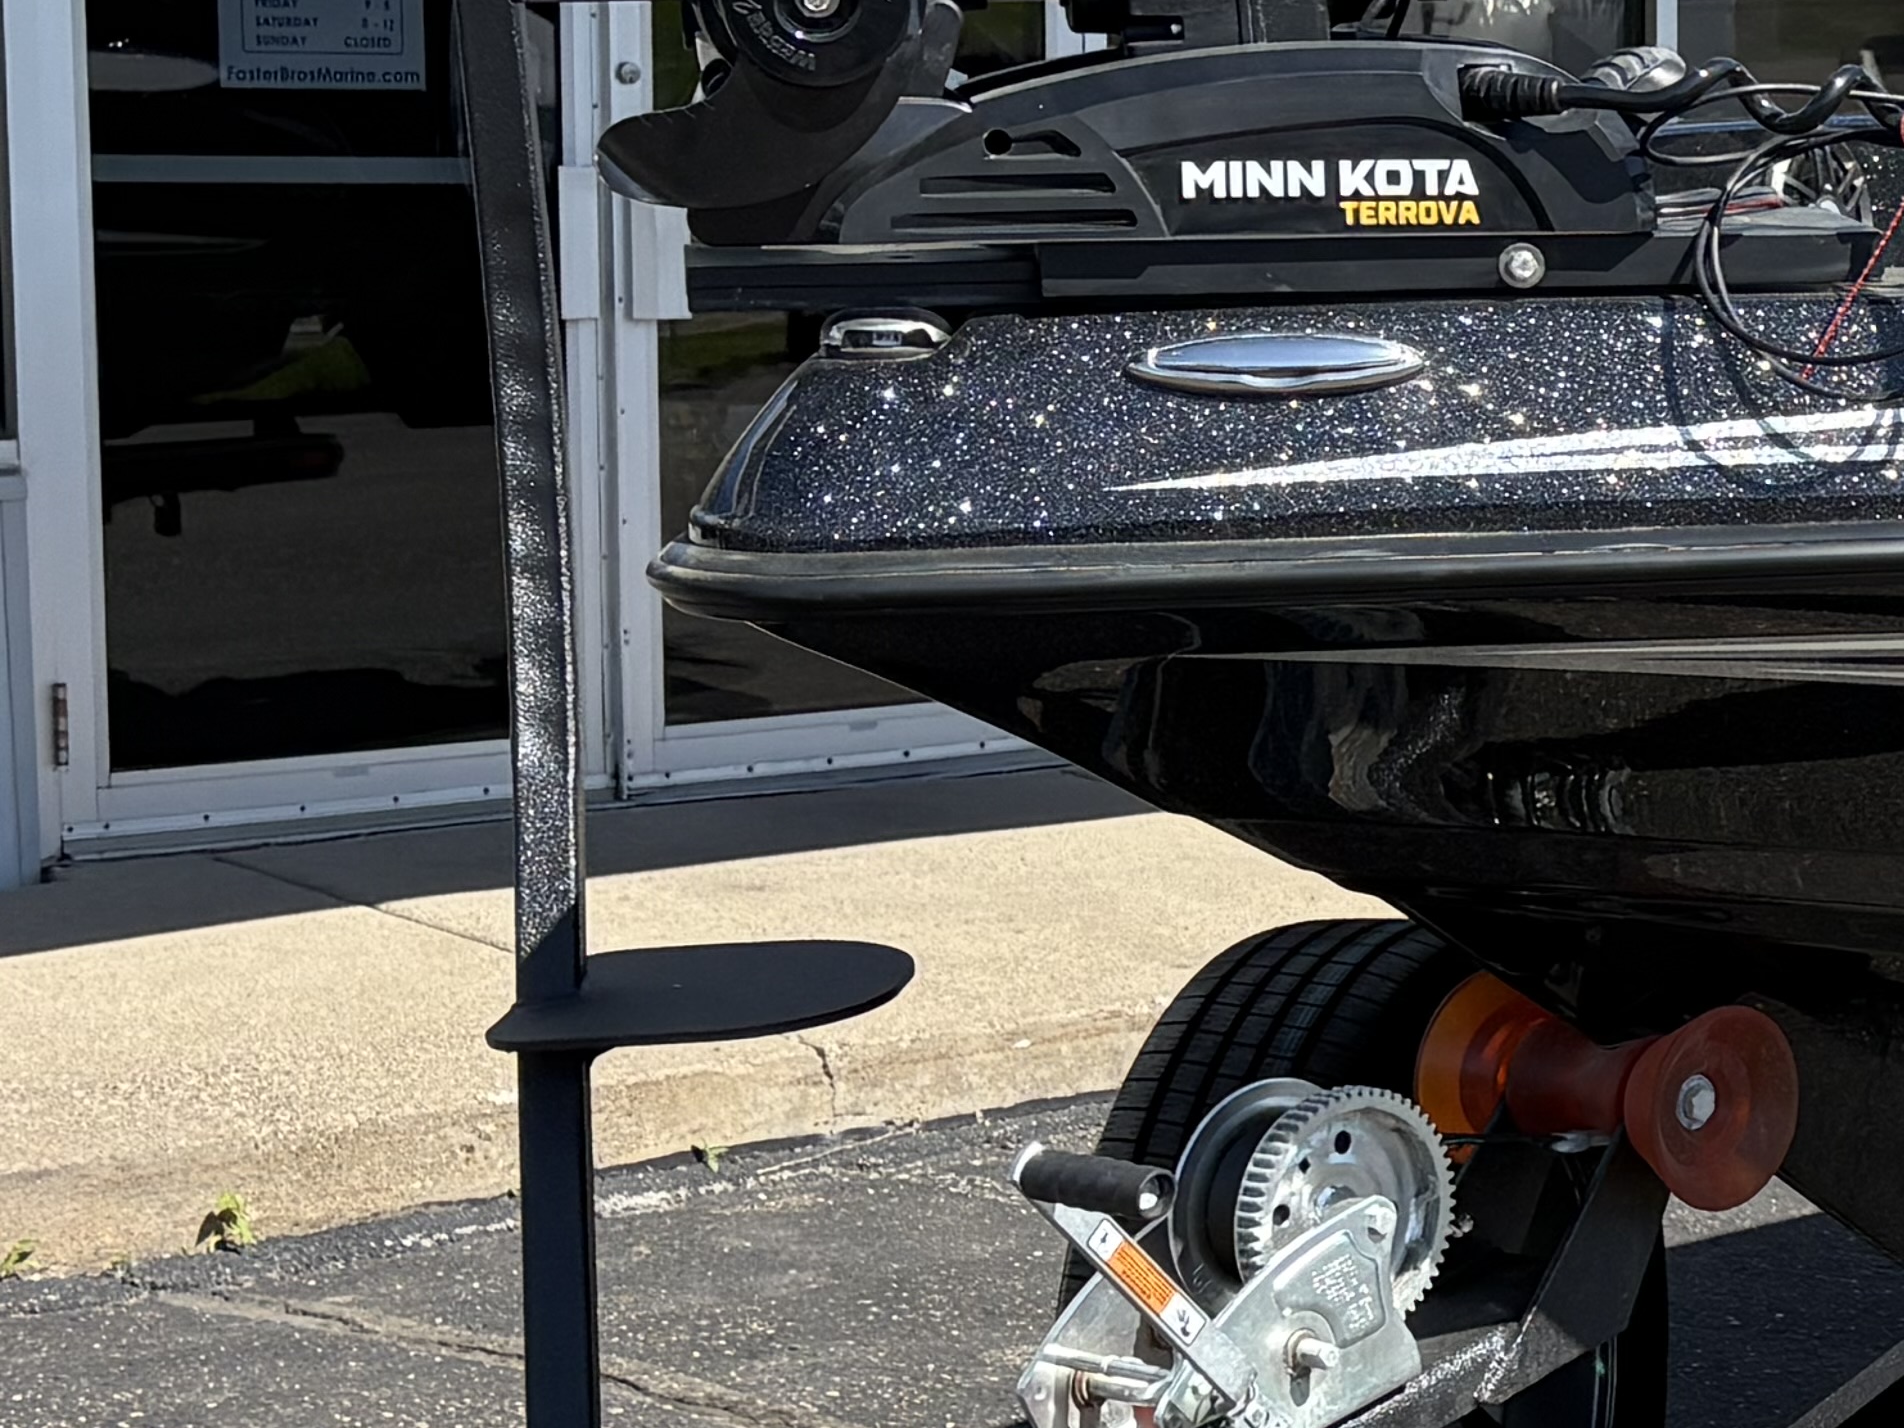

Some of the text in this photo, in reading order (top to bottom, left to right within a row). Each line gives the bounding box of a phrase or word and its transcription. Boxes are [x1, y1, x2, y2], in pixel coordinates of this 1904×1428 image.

[255, 15, 319, 28] SATURDAY
[255, 34, 392, 49] SUNDAY CLOSED
[226, 64, 421, 84] FosterBrosMarine.com
[1181, 158, 1480, 199] MINN KOTA
[1338, 199, 1481, 227] TERROVA
